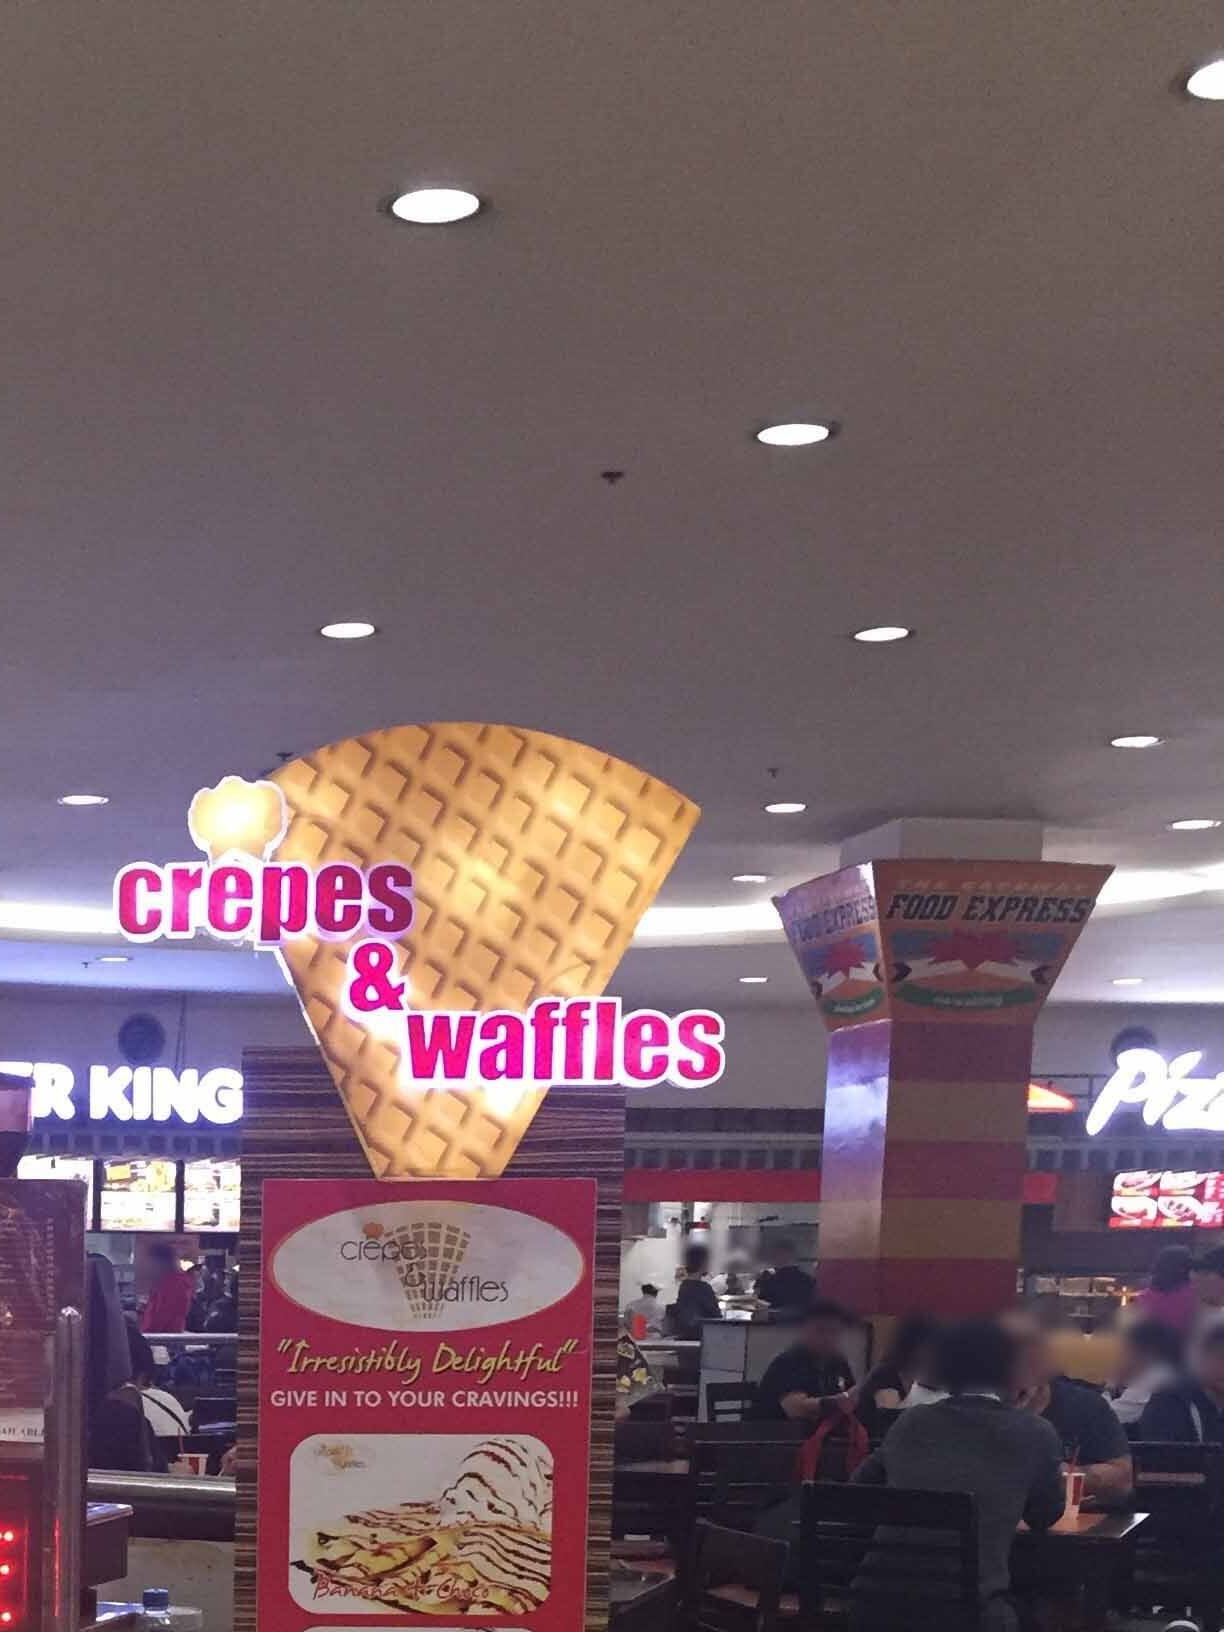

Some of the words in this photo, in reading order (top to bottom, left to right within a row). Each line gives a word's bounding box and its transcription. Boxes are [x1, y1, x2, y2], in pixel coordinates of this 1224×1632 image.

[116, 861, 415, 945] crepes
[886, 893, 959, 920] FOOD
[962, 895, 1091, 923] EXPRESS
[348, 941, 406, 1011] &
[406, 1001, 724, 1083] waffles
[89, 1064, 244, 1125] KING
[270, 1390, 317, 1409] GIVE
[325, 1391, 349, 1408] IN
[354, 1391, 382, 1408] TO
[387, 1391, 445, 1409] YOUR
[451, 1390, 579, 1410] CRAVINGS!!!
